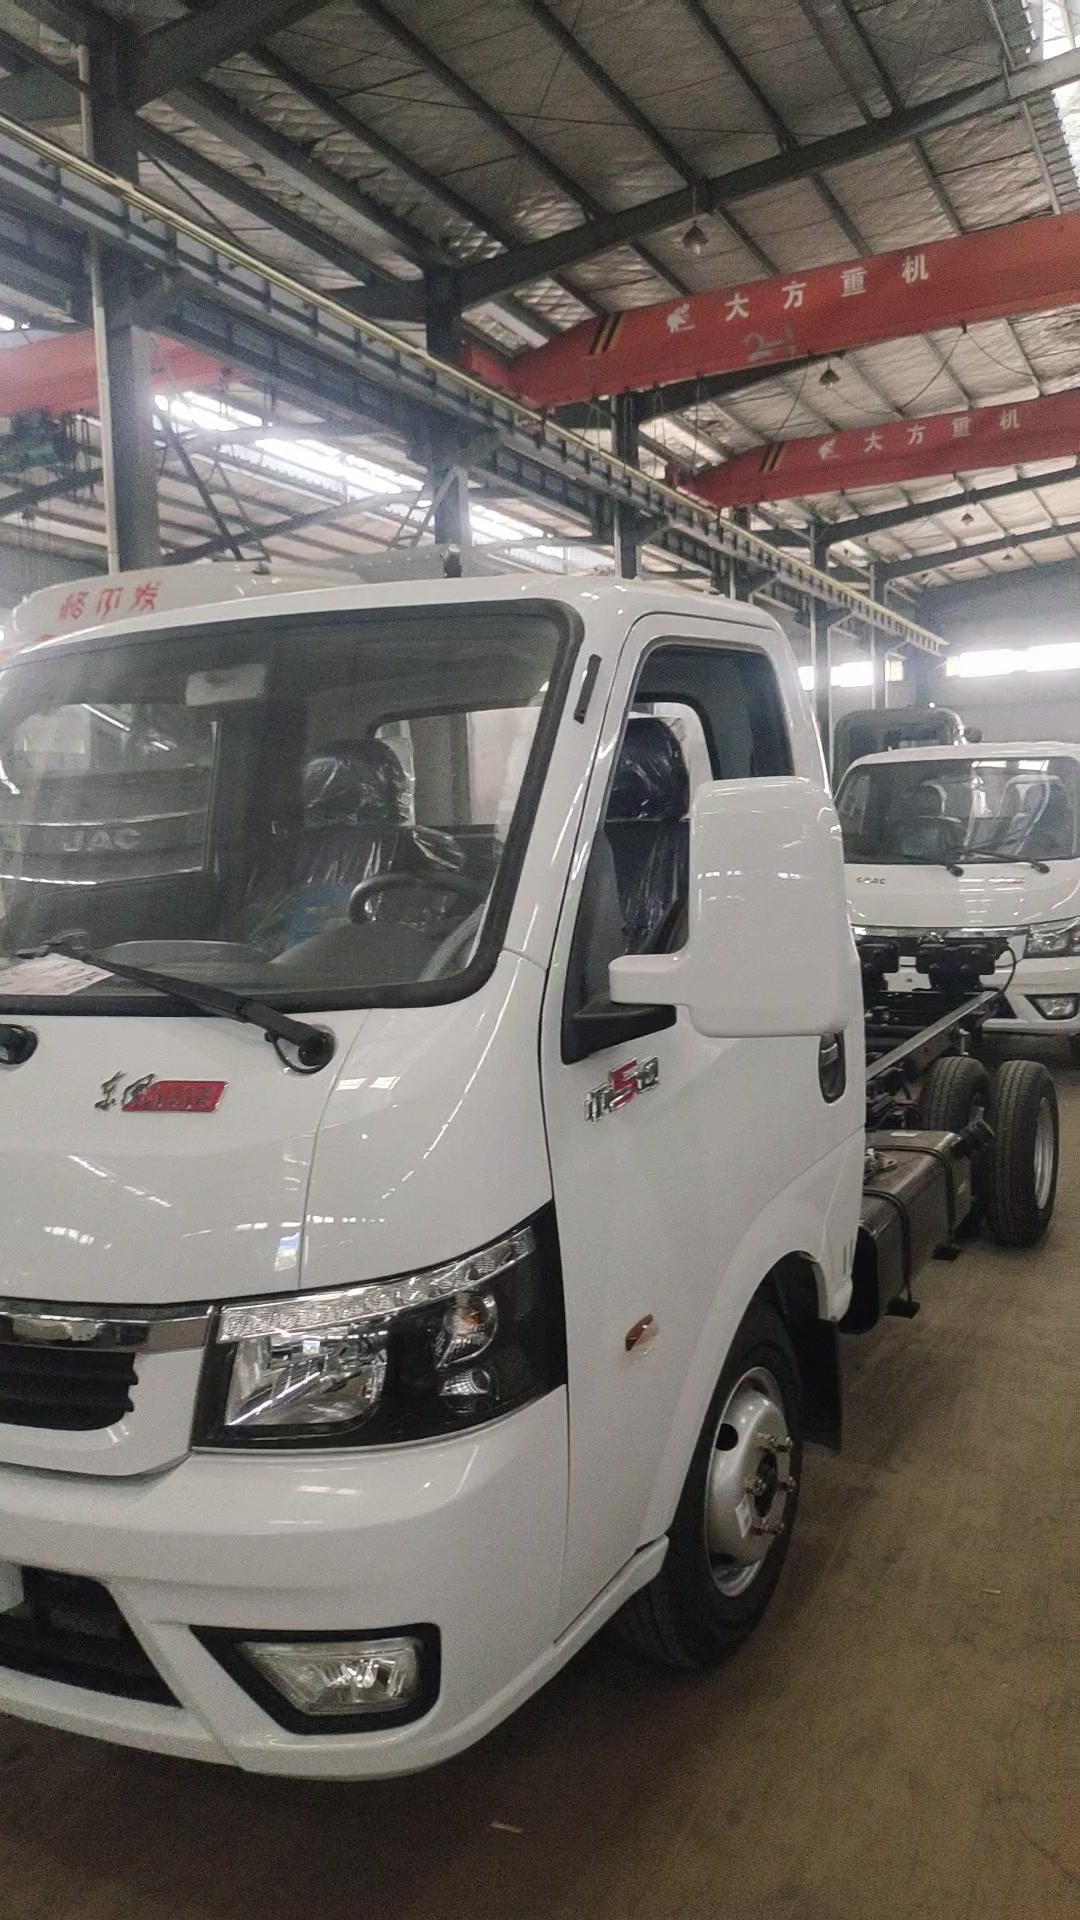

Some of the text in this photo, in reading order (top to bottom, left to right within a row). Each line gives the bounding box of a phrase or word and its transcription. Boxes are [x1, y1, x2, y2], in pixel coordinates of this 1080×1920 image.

[725, 253, 929, 322] 大方重机
[864, 409, 1020, 452] 大方重机
[58, 579, 161, 621] 格尔发
[63, 828, 141, 852] JAC
